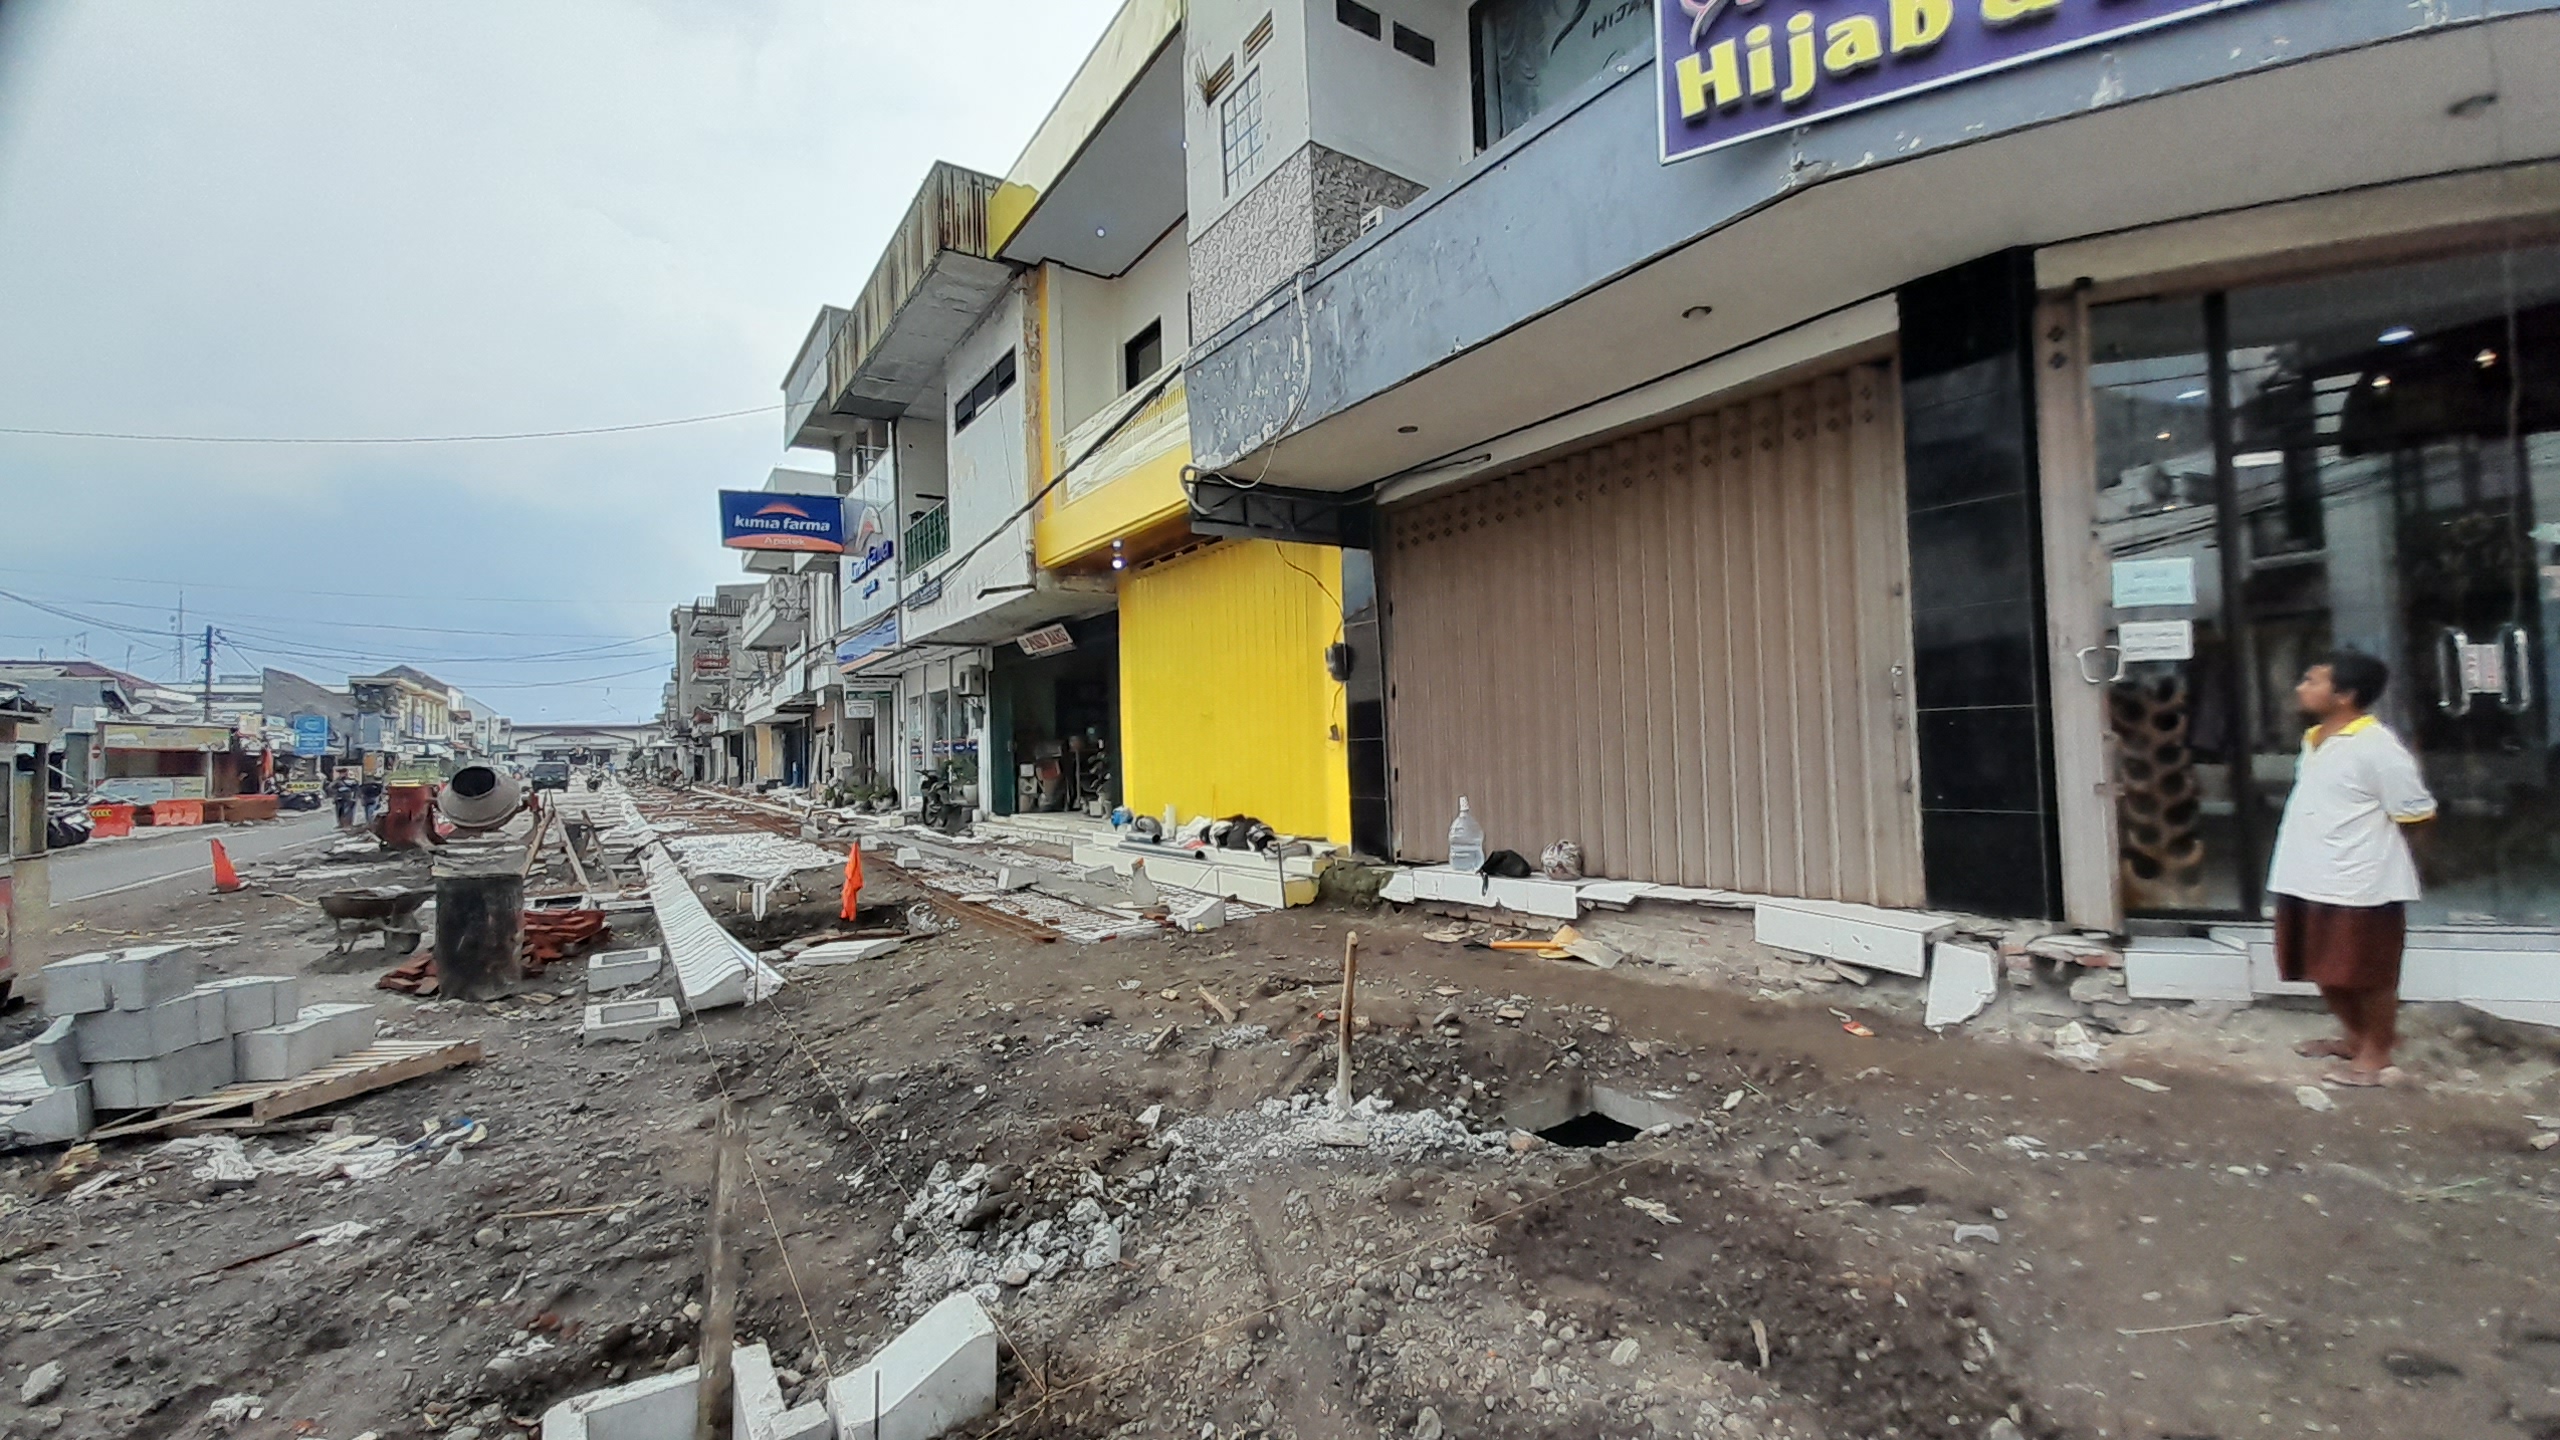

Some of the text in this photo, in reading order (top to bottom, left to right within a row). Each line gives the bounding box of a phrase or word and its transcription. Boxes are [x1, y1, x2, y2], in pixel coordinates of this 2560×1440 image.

[1675, 0, 1953, 118] Hijab
[734, 514, 831, 532] kimia farma
